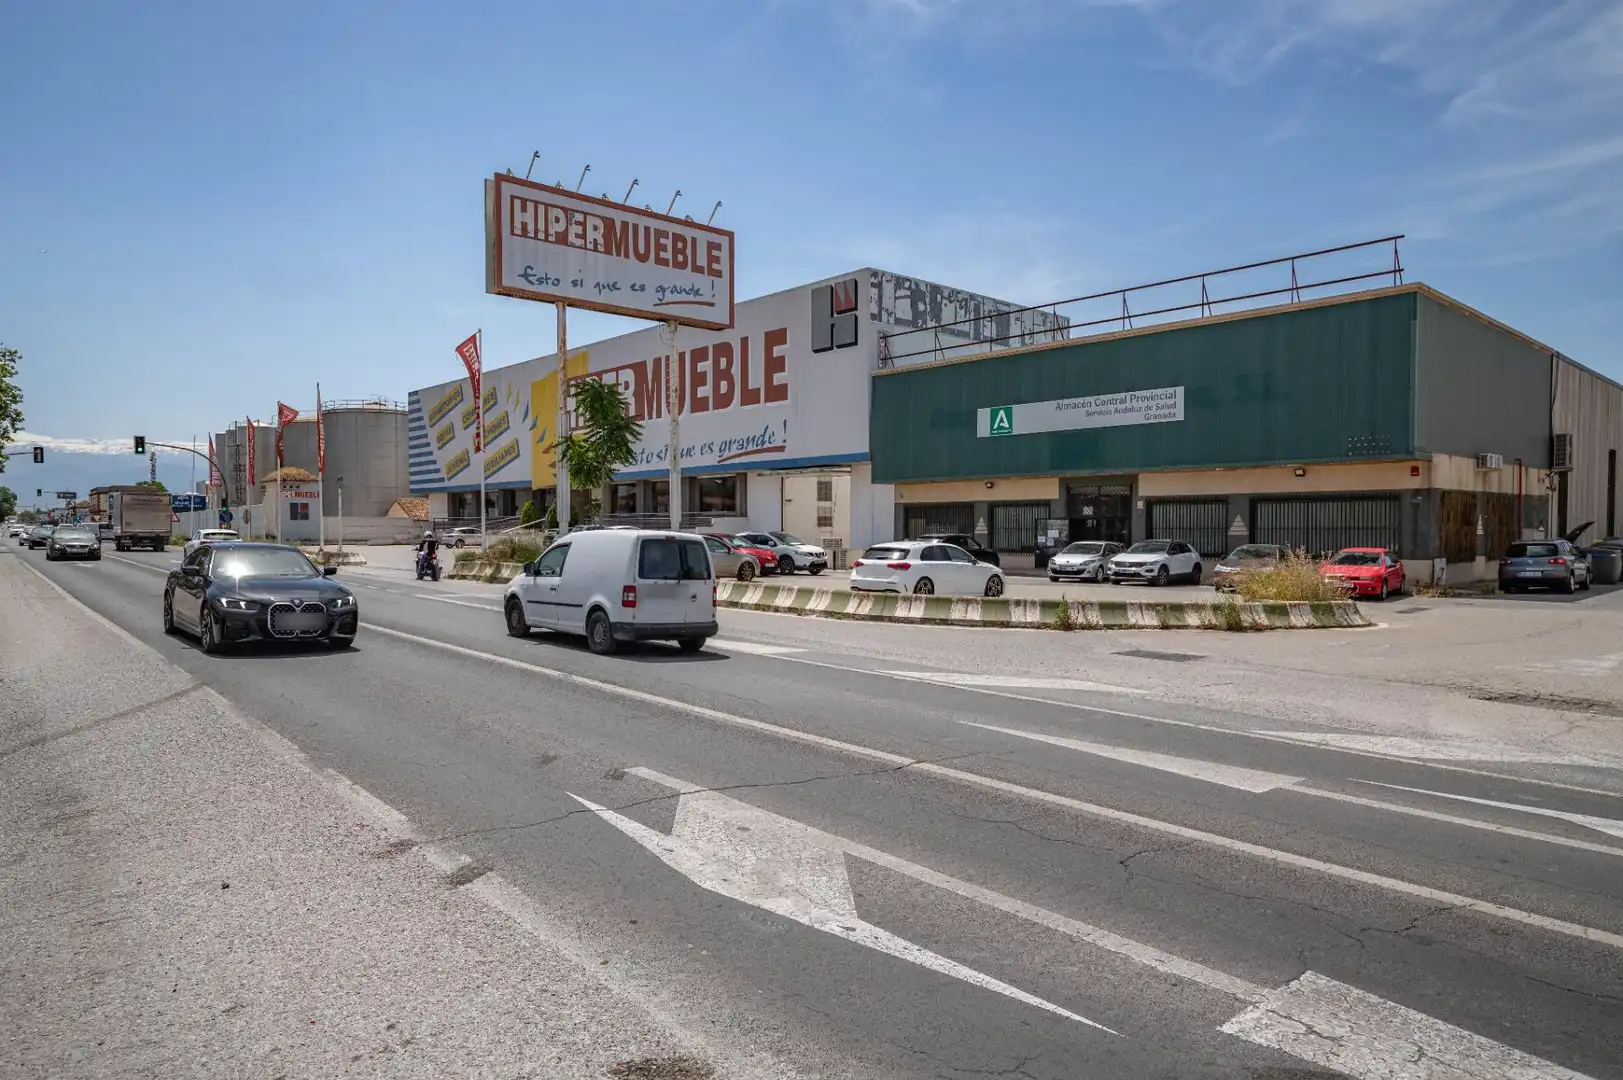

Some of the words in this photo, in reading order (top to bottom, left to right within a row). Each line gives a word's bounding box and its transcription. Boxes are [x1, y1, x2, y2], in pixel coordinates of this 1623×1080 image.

[517, 265, 561, 287] Esto
[593, 280, 622, 296] que
[630, 281, 646, 292] es
[655, 285, 704, 301] grande
[1055, 400, 1092, 412] Almacén
[1094, 396, 1127, 407] Central
[1130, 389, 1177, 404] Provincial
[1085, 408, 1112, 418] Servicio
[1113, 404, 1142, 415] Andaluz
[1144, 402, 1154, 412] de
[1155, 401, 1177, 411] Salud
[1144, 411, 1176, 421] Granada
[700, 441, 714, 457] es
[718, 425, 776, 458] grande
